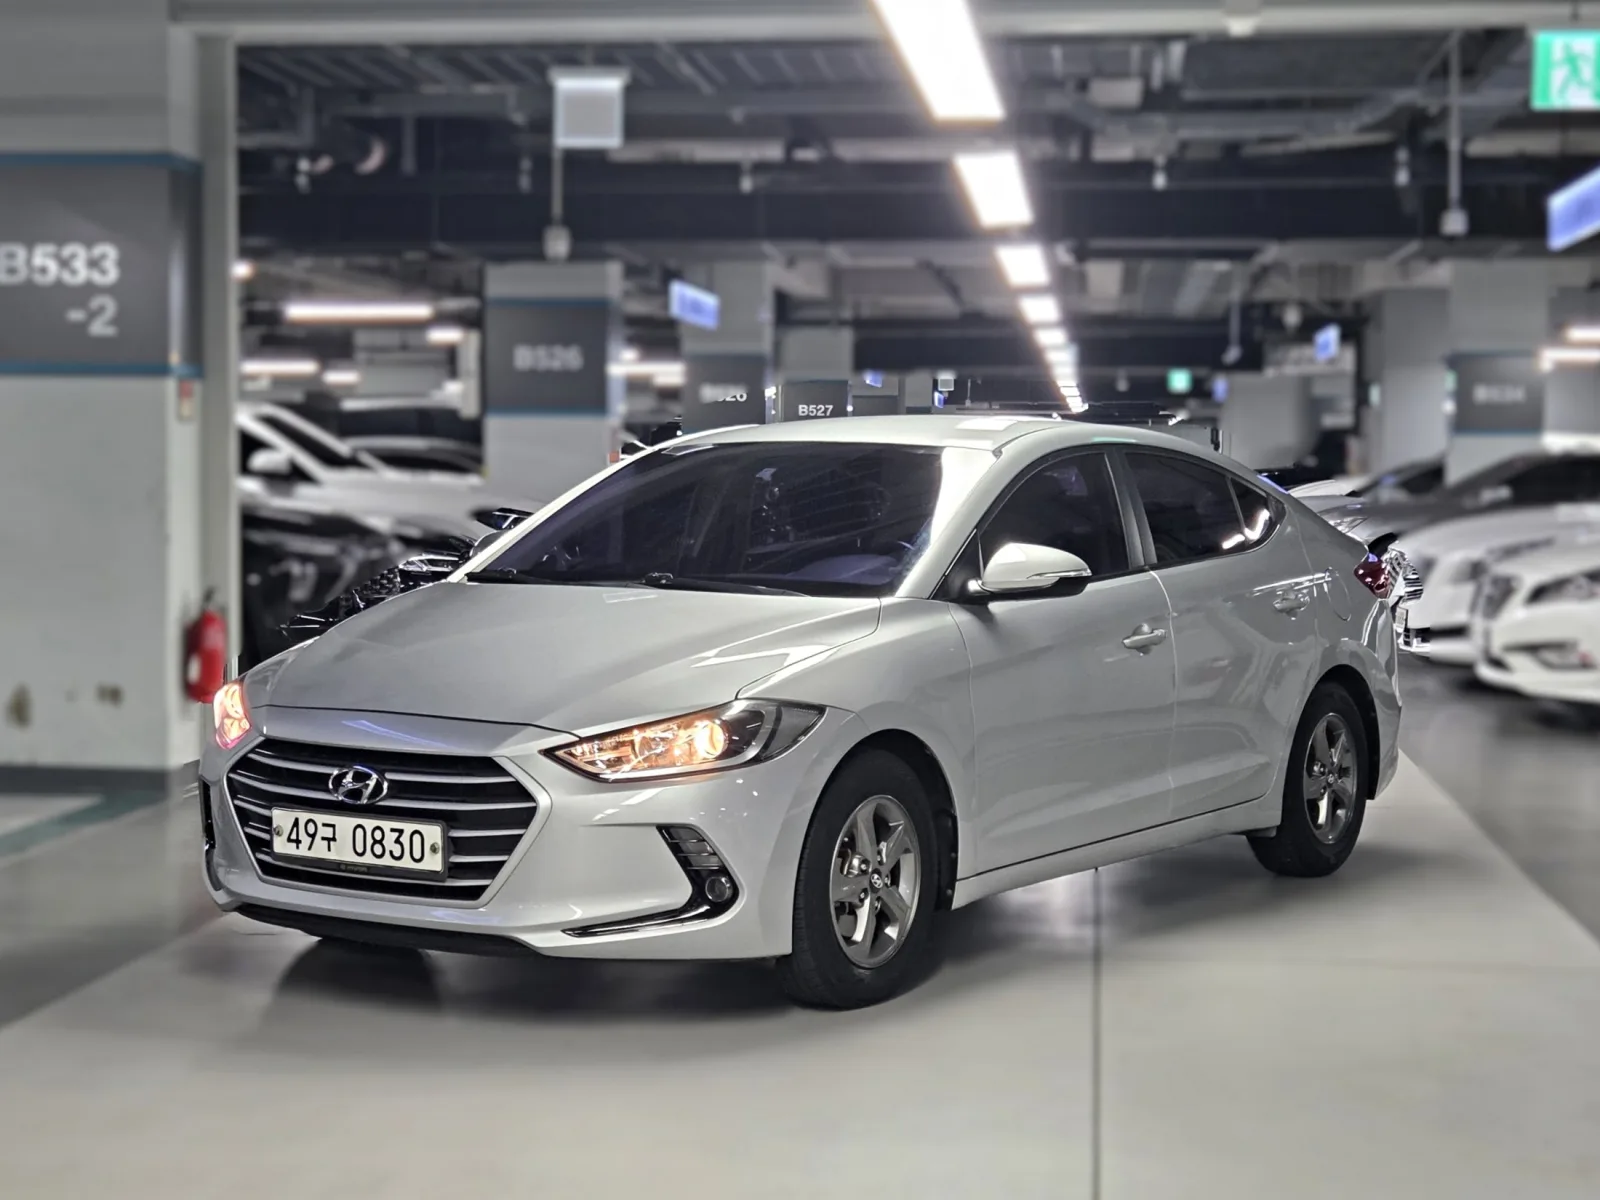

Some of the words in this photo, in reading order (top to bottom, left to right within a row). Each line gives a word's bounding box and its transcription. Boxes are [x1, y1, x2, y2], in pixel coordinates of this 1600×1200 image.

[0, 241, 120, 286] B533
[65, 294, 119, 337] -2
[798, 404, 834, 417] B527
[286, 817, 337, 852] 49구
[352, 823, 425, 863] 0830
